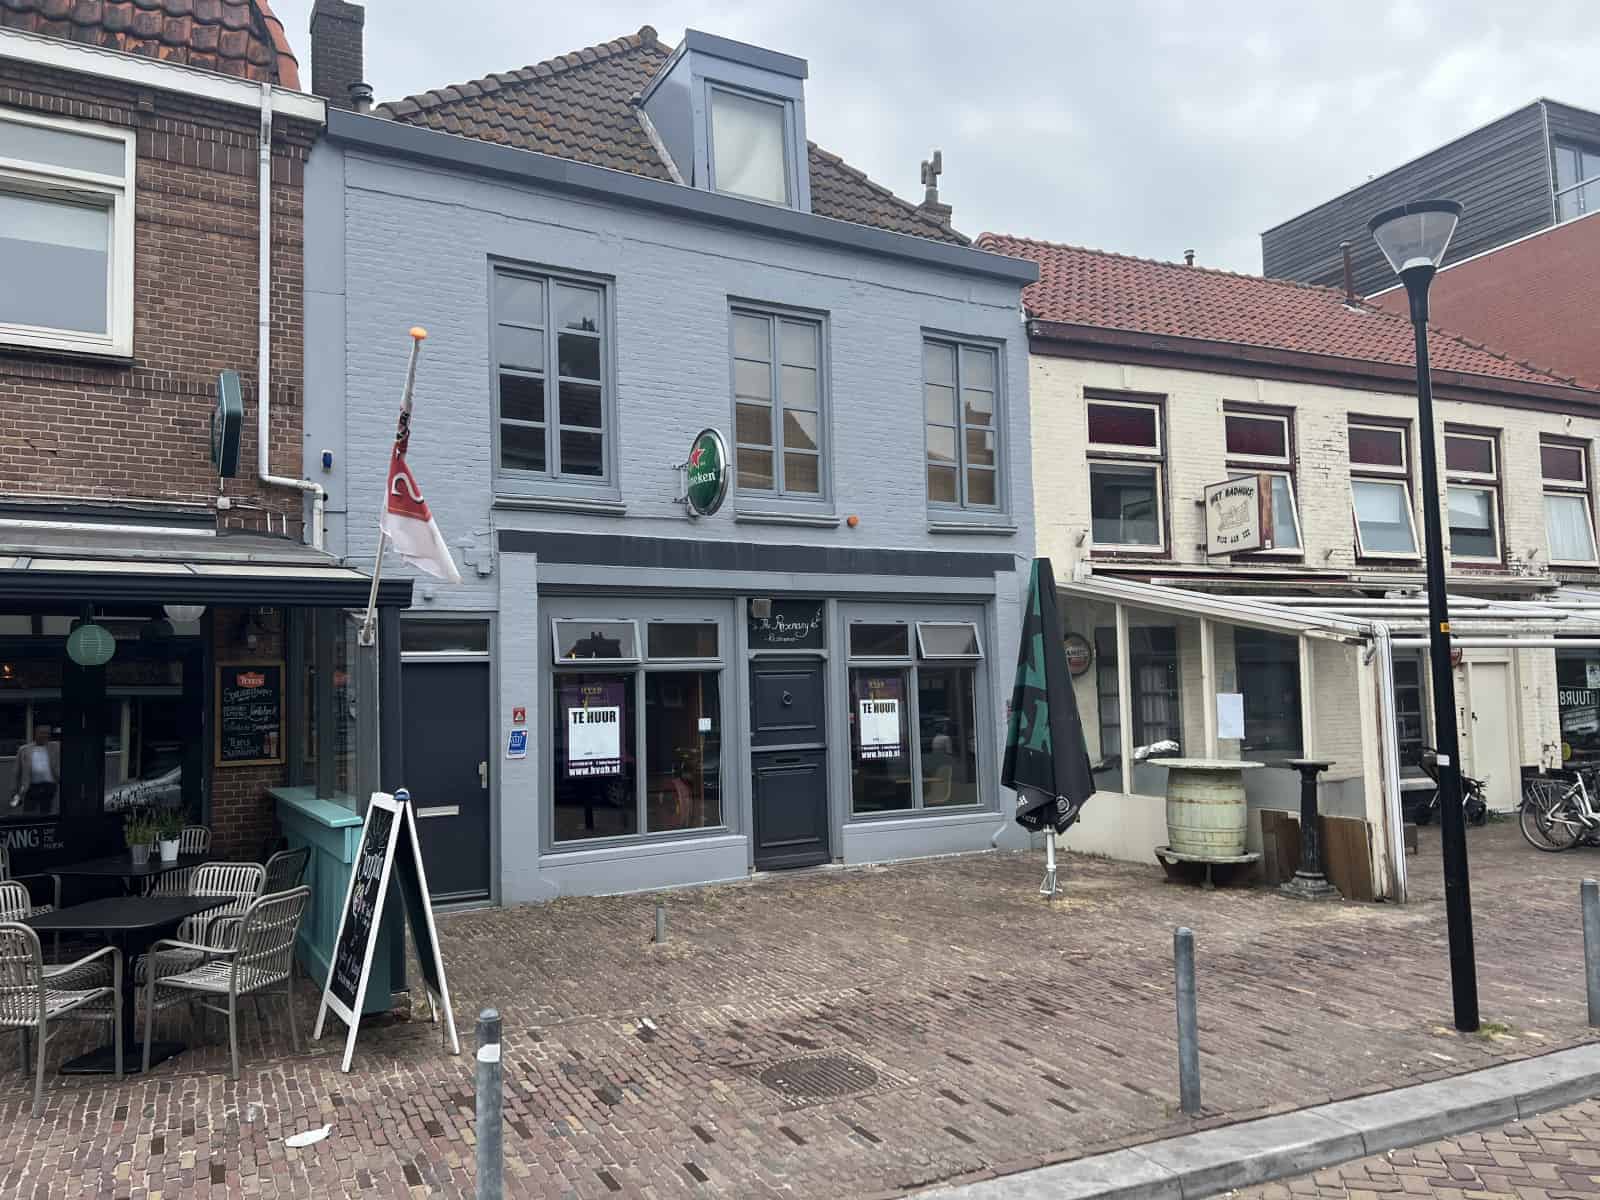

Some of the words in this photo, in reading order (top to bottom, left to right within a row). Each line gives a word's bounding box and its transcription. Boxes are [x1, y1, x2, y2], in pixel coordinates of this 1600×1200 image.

[863, 703, 872, 713] TE
[873, 703, 896, 713] HUUR
[572, 711, 584, 724] TE
[587, 711, 616, 723] HUUR
